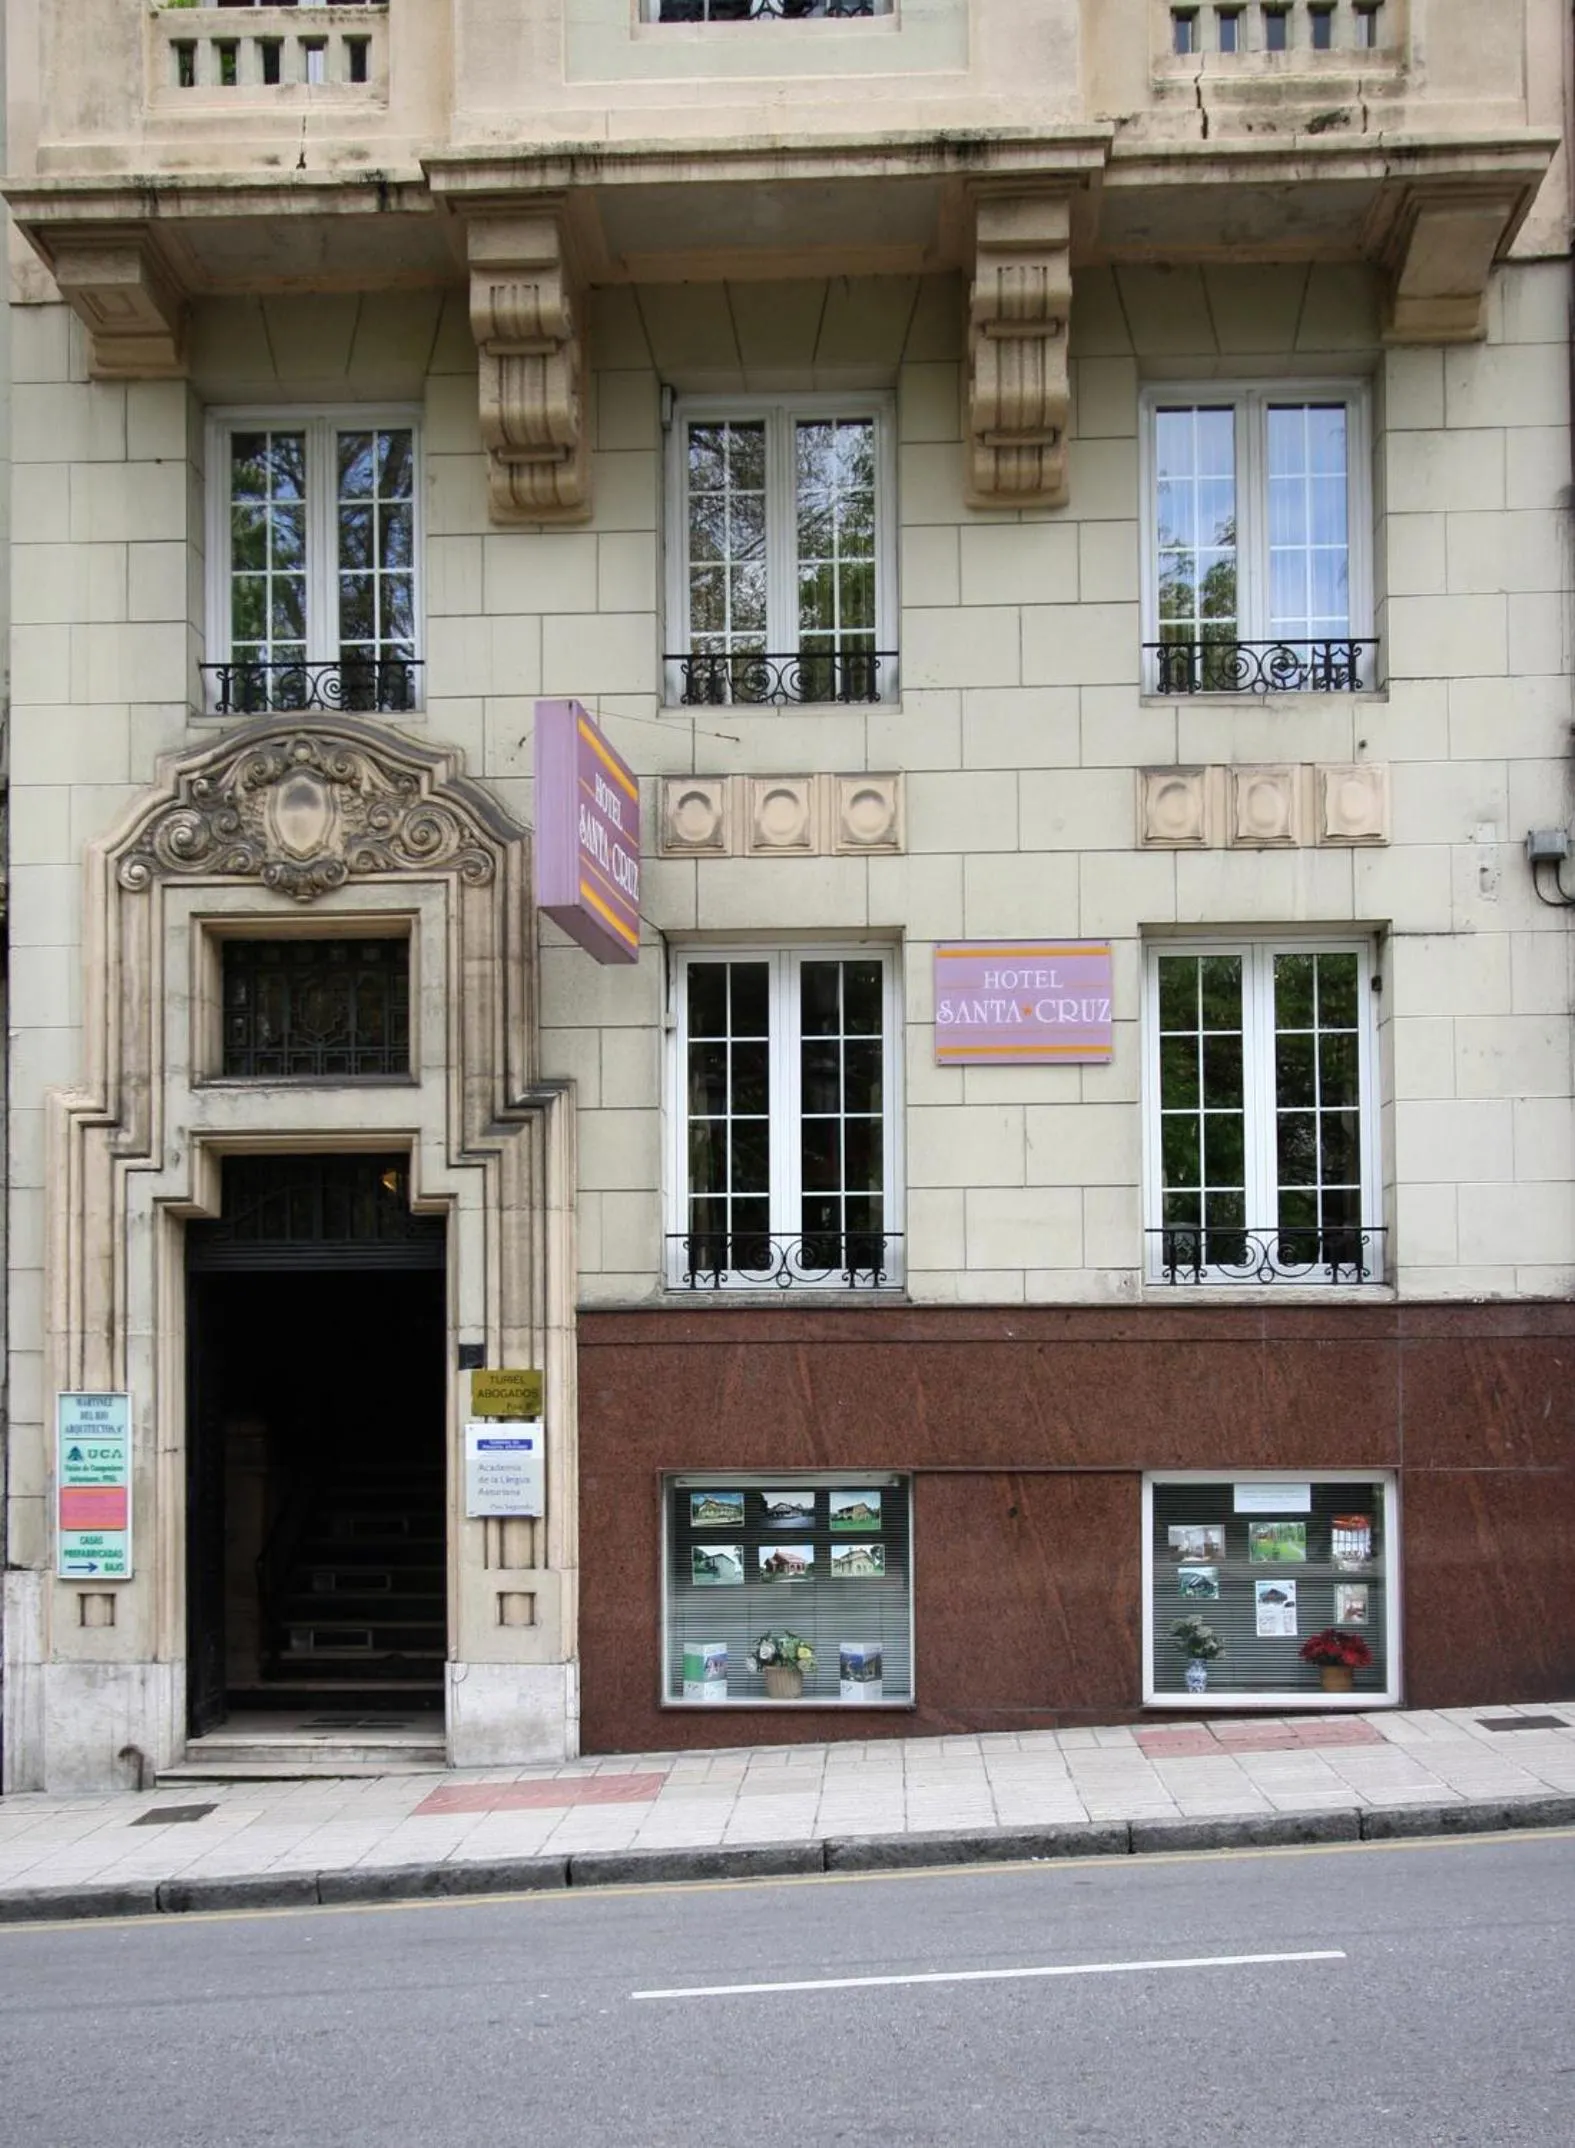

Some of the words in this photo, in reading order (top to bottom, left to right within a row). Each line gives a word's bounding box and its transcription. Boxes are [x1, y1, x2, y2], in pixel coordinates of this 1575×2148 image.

[594, 771, 624, 831] HOTEL
[578, 802, 610, 872] SANTA
[612, 842, 640, 901] CRUZ
[983, 969, 1064, 990] HOTEL
[936, 998, 1023, 1025] SANTA
[1034, 998, 1112, 1023] CRUZ
[477, 1387, 539, 1399] ABOGADOS
